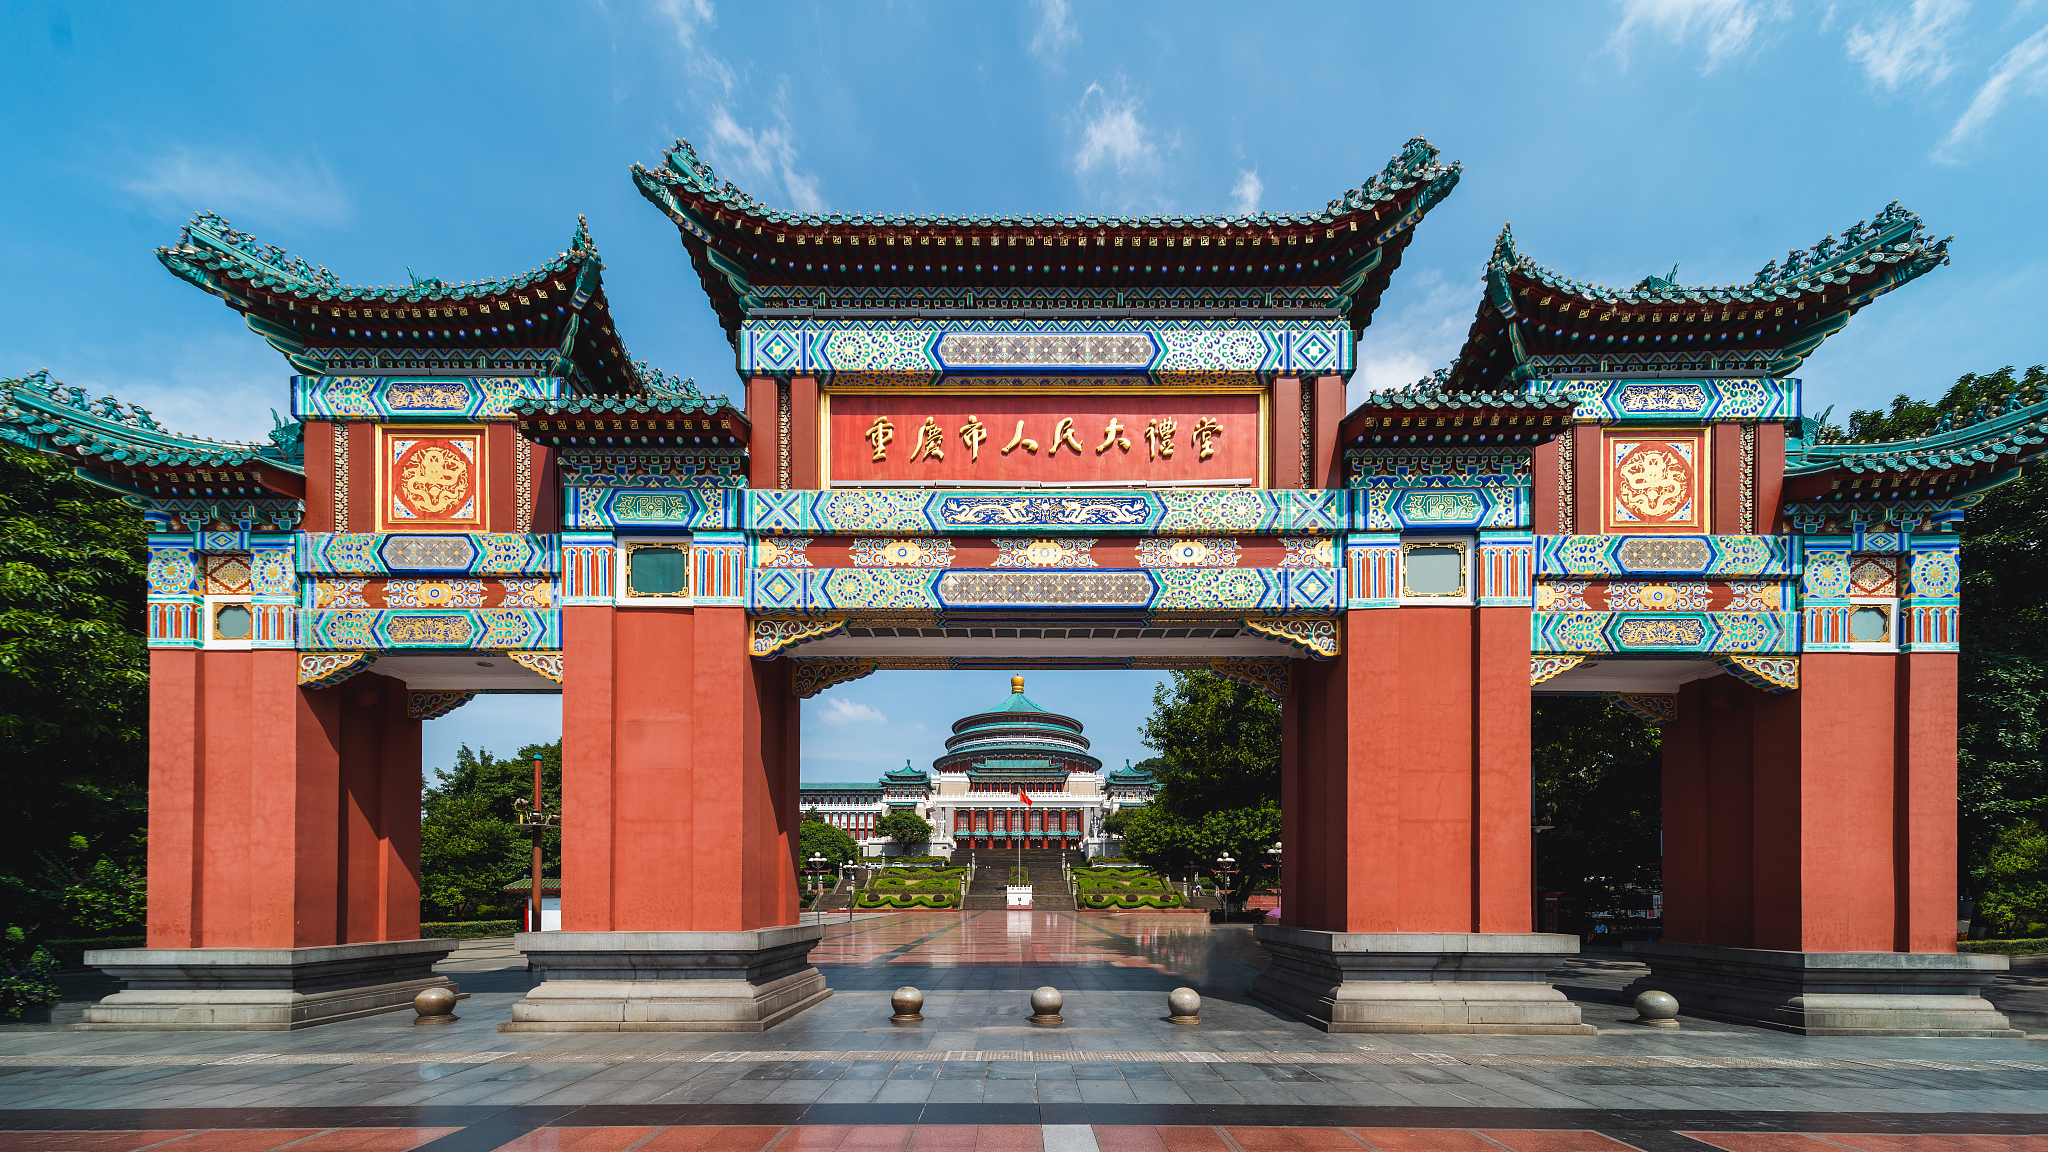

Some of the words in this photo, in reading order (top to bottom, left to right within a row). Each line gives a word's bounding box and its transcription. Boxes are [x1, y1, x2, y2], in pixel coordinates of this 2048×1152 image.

[865, 414, 1223, 461] 重慶市人民大禮堂
